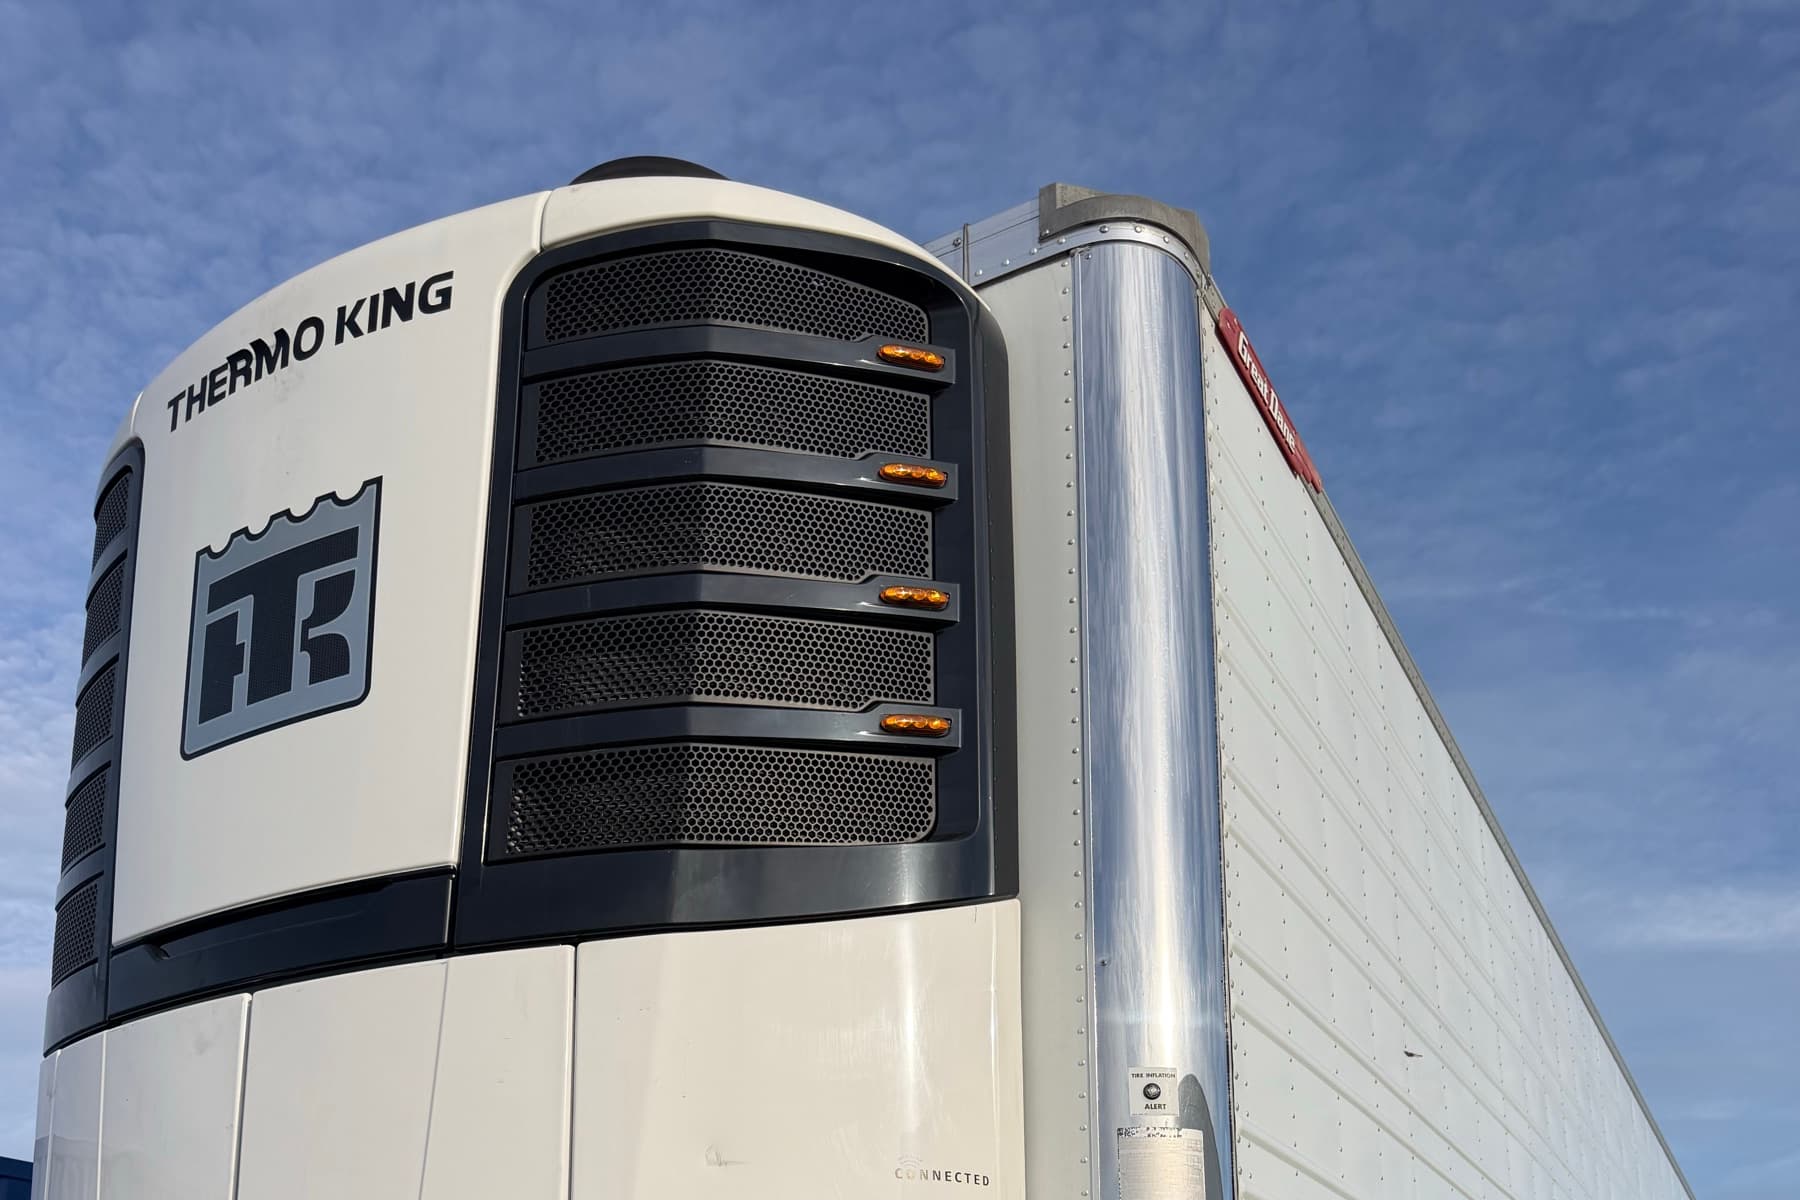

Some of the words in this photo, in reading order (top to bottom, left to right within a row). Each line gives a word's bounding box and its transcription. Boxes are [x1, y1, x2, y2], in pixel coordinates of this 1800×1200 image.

[167, 315, 325, 433] THERMO
[334, 270, 454, 346] KING
[1237, 330, 1269, 407] Great
[1267, 387, 1297, 453] Dane
[894, 1167, 990, 1187] CONNECTED
